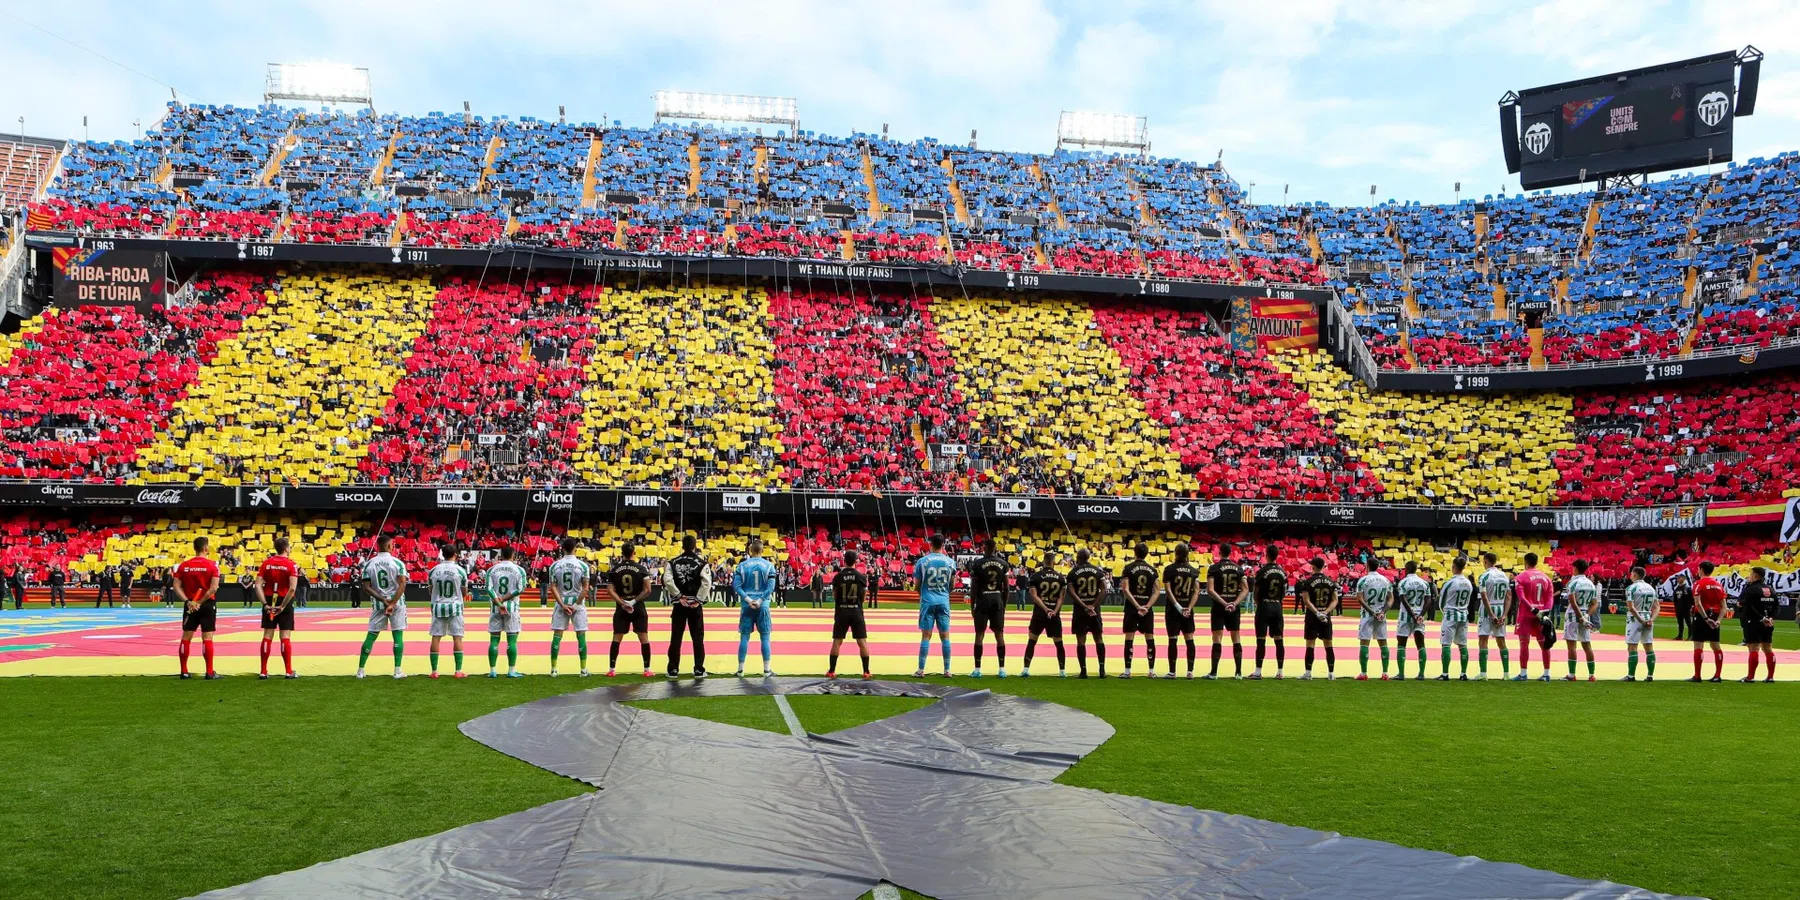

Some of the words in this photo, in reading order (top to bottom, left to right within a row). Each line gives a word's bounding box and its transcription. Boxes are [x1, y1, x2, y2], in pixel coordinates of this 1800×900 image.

[1610, 106, 1634, 118] UNITS
[1605, 121, 1639, 135] SEMPRE
[92, 240, 115, 251] 1963
[252, 246, 275, 257] 1967
[407, 250, 428, 261] 1971
[606, 258, 615, 267] IS
[618, 258, 662, 269] MESTALLA
[71, 266, 150, 283] RIBA-ROJA
[799, 264, 813, 274] WE
[815, 264, 845, 276] THANK
[847, 266, 865, 277] OUR
[868, 267, 893, 278] FANS!
[1020, 275, 1039, 286] 1979
[1151, 282, 1170, 293] 1980
[1703, 281, 1733, 291] AMSTE
[79, 285, 97, 300] DE
[99, 281, 142, 302] TÚRIA
[1276, 291, 1295, 300] 1980
[1520, 302, 1547, 310] AMSTEL
[1249, 317, 1302, 338] AMUNT
[1658, 365, 1683, 377] 1999
[1467, 377, 1489, 387] 1999
[41, 485, 74, 496] divina
[137, 488, 183, 504] Coca-Cola
[440, 493, 453, 501] TM
[532, 490, 573, 503] divina
[625, 495, 658, 506] PUMA
[725, 496, 738, 504] TM
[812, 498, 844, 509] PUMA
[905, 496, 944, 509] divina
[997, 502, 1010, 510] TM
[1330, 507, 1355, 516] divina
[1450, 513, 1488, 523] AMSTEL
[1555, 511, 1573, 531] LA
[1573, 510, 1617, 530] CURVA
[378, 569, 389, 590] 6
[563, 571, 574, 592] 5
[622, 573, 633, 595] 9
[753, 570, 760, 592] 1
[927, 567, 947, 587] 25
[987, 570, 997, 591] 3
[1137, 574, 1147, 595] 8
[1174, 575, 1192, 596] 24
[1221, 573, 1238, 593] 15
[437, 579, 454, 599] 10
[498, 576, 509, 596] 8
[842, 583, 858, 603] 14
[1040, 581, 1061, 601] 22
[1077, 576, 1097, 596] 20
[1268, 578, 1280, 598] 5
[1493, 582, 1507, 601] 16
[1536, 582, 1543, 602] 1
[1314, 588, 1329, 607] 16
[1368, 588, 1387, 606] 24
[1406, 589, 1425, 607] 23
[1455, 589, 1469, 607] 19
[1577, 589, 1595, 607] 34
[1641, 594, 1654, 612] 15
